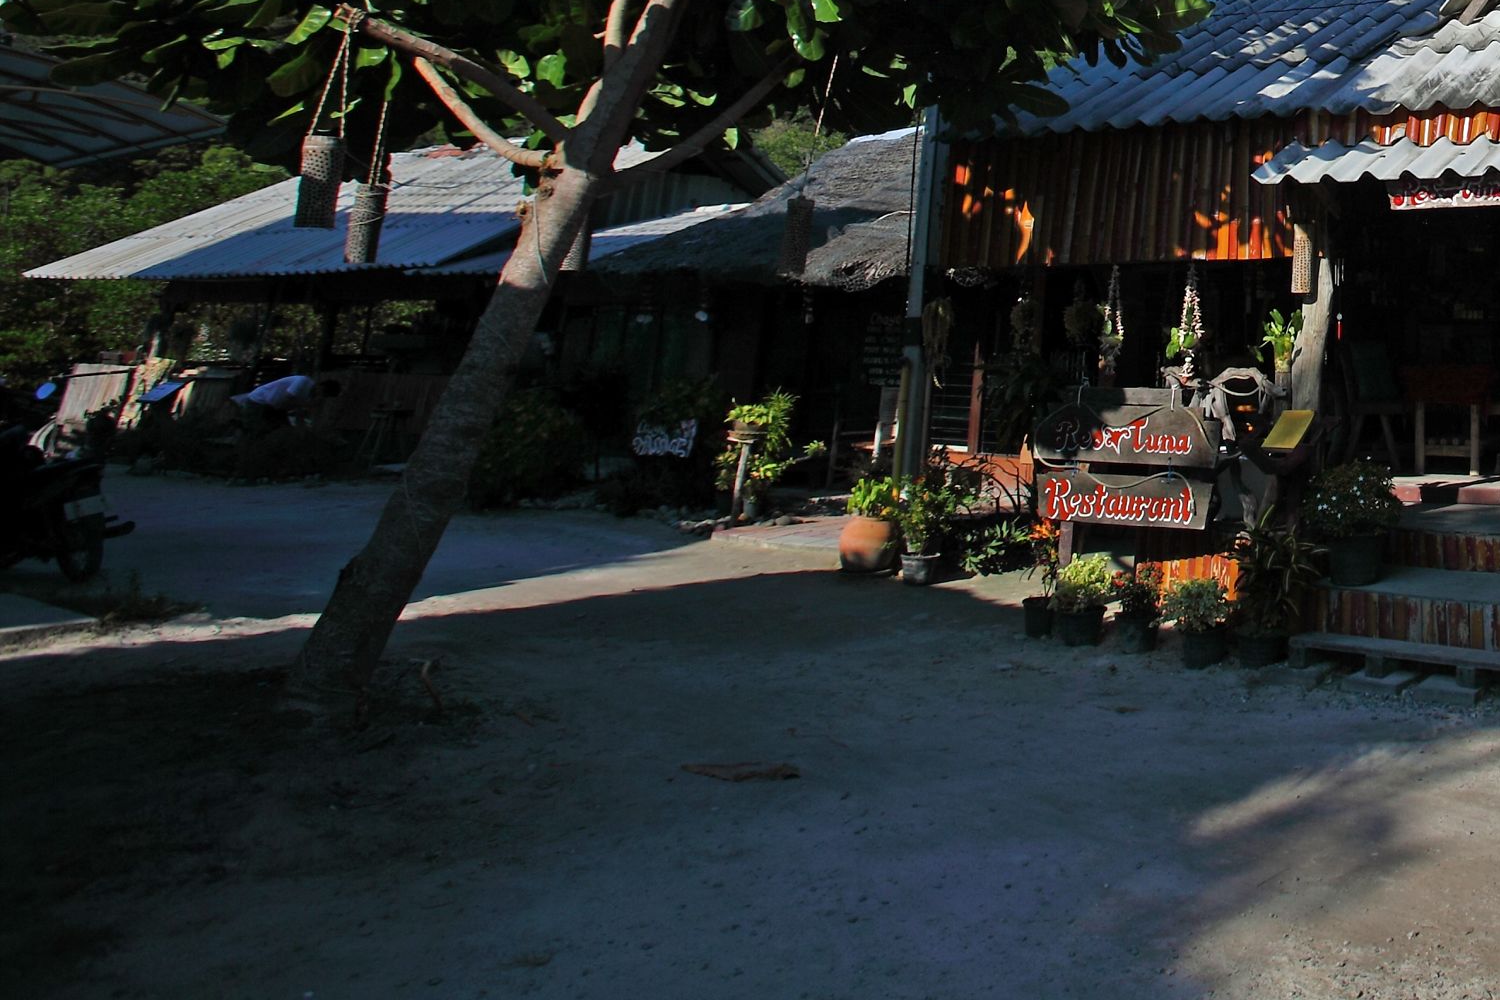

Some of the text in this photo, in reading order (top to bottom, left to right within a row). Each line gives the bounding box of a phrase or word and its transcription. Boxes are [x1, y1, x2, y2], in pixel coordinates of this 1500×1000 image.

[1055, 417, 1192, 455] Red Tuna
[1045, 478, 1194, 526] Restaurant
